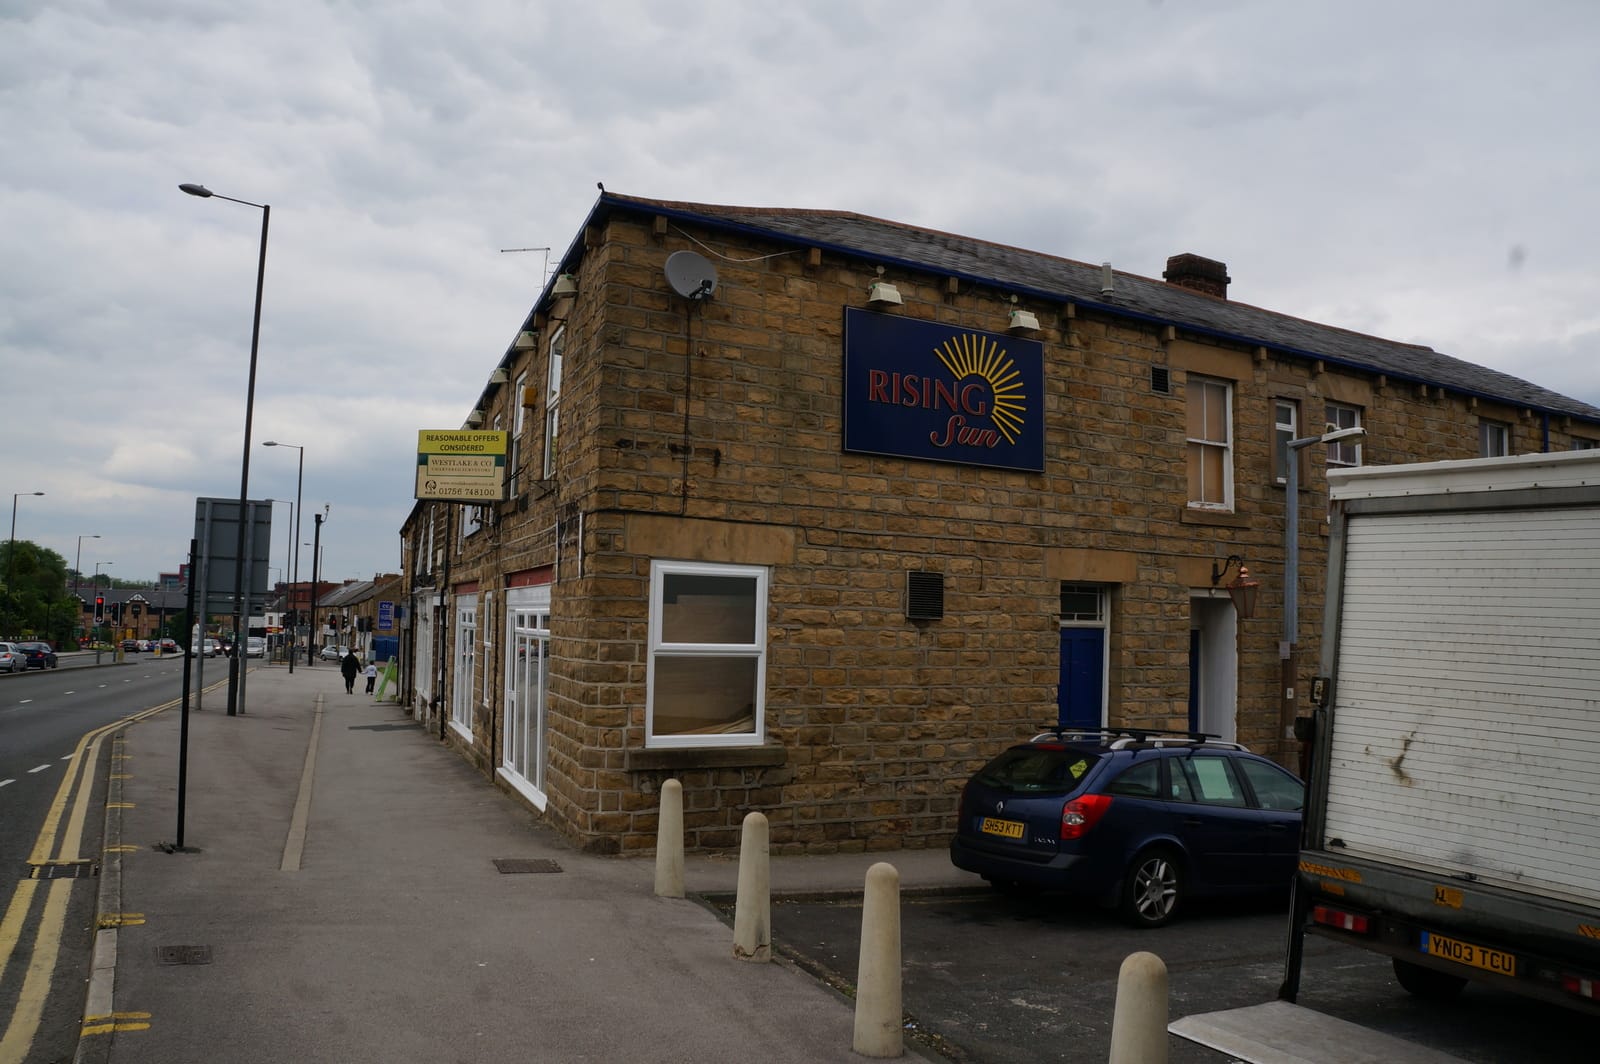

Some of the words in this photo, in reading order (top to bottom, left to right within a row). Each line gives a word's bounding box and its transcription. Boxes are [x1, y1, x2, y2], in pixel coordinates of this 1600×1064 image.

[869, 369, 986, 416] RISING
[930, 415, 1002, 449] Sun
[465, 488, 495, 496] 748100
[984, 819, 1004, 833] SH53
[1005, 823, 1023, 836] KTT
[1433, 936, 1473, 962] YN03
[1479, 949, 1512, 972] TCU
